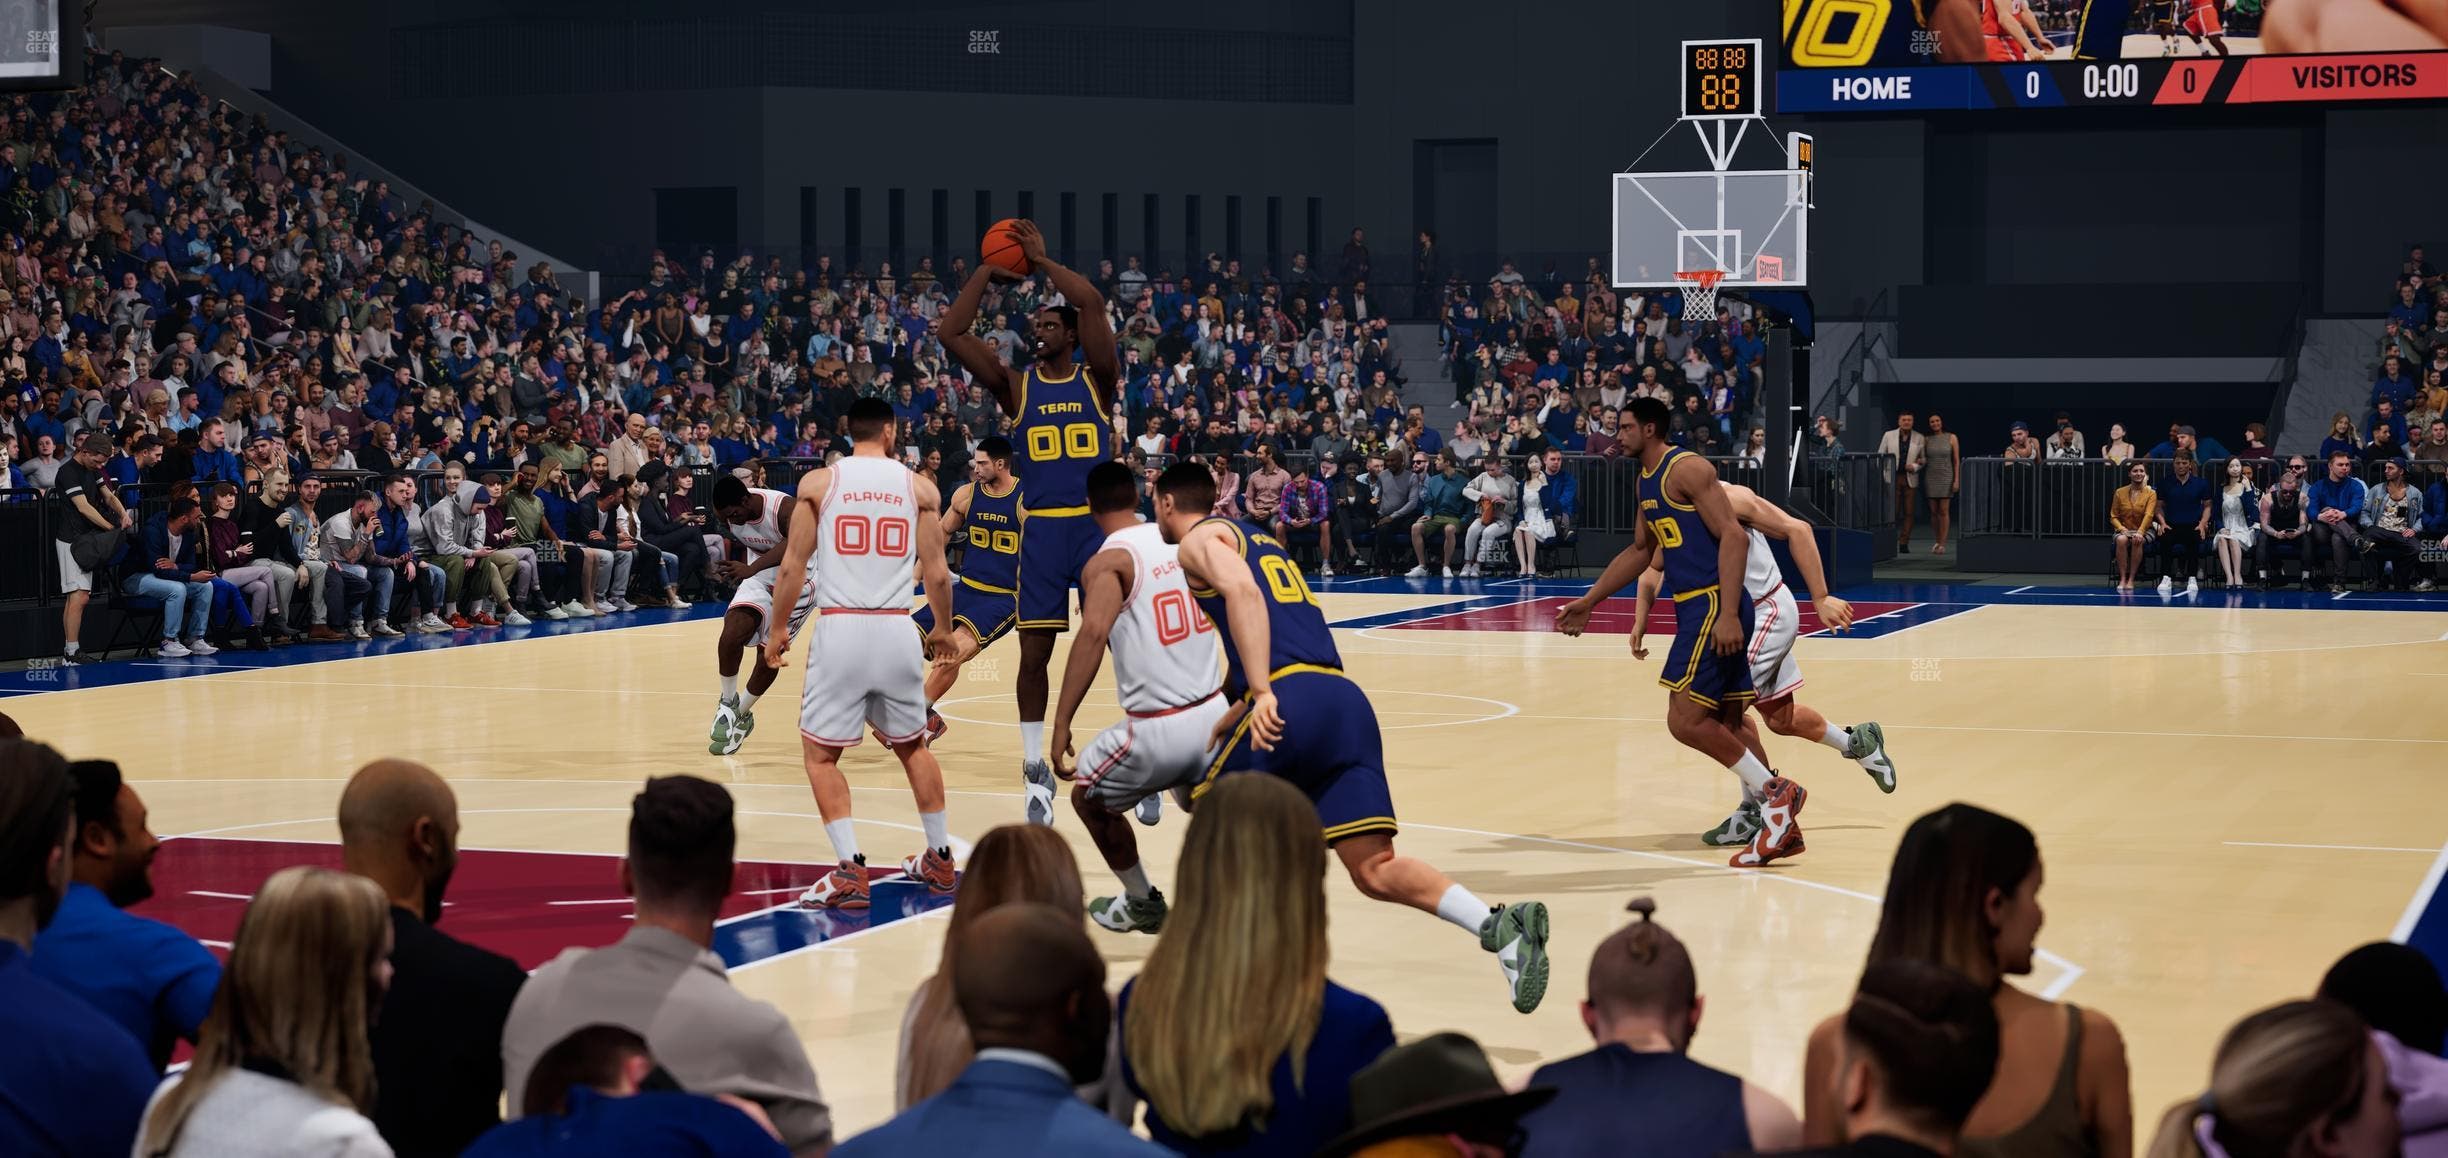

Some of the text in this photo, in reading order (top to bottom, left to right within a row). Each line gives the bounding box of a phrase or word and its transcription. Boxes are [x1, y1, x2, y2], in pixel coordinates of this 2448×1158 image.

[1696, 48, 1745, 70] 88 88
[1832, 77, 1912, 101] HOME
[2026, 72, 2039, 98] 0
[2083, 64, 2139, 98] 0:00
[2183, 68, 2196, 94] 0
[2292, 63, 2417, 89] VISITORS
[1701, 74, 1740, 110] 88
[1038, 402, 1082, 415] TEAM
[1027, 423, 1099, 462] 00
[843, 491, 903, 506] PLAYER
[976, 512, 1008, 524] TEAM
[835, 515, 909, 557] 00
[969, 526, 1019, 555] 00
